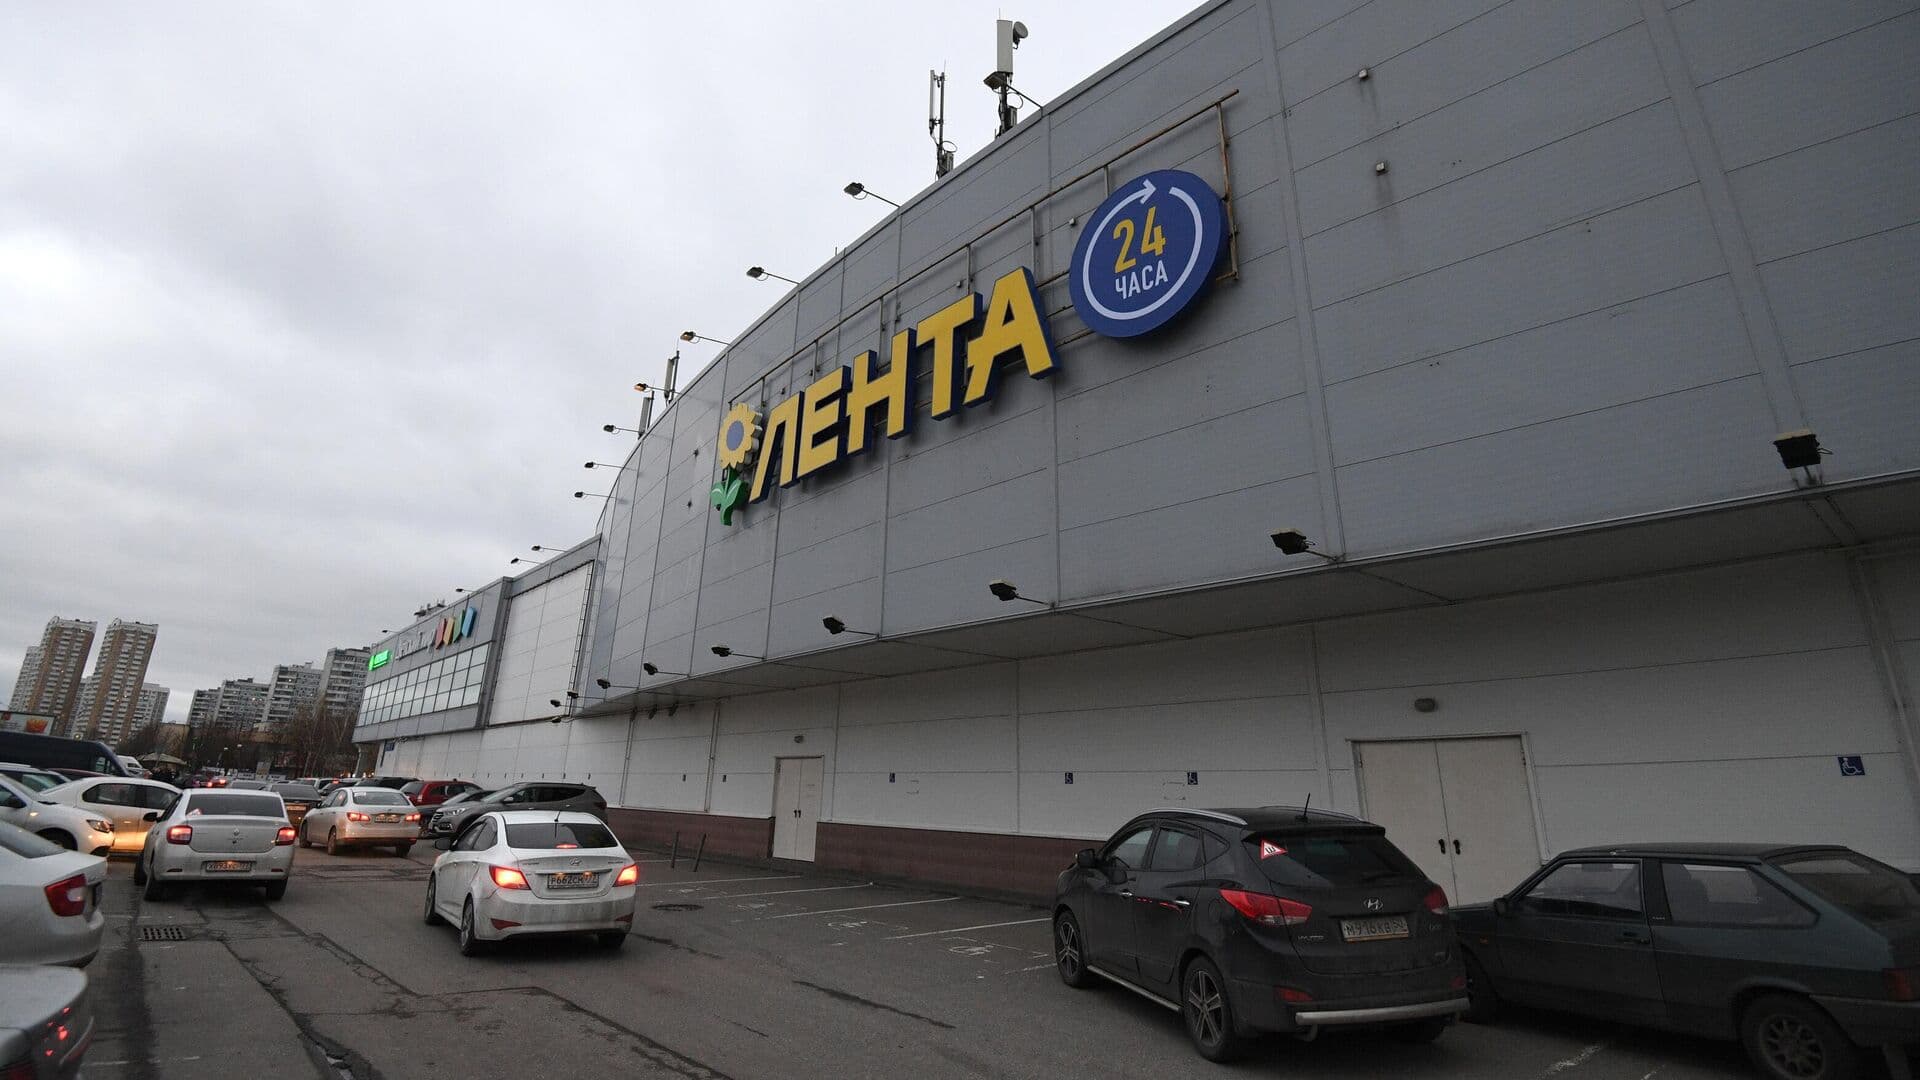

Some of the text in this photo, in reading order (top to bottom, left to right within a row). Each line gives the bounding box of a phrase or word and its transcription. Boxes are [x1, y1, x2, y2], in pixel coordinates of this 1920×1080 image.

[1113, 206, 1166, 273] 24
[1115, 259, 1168, 299] ЧАСА
[748, 265, 1057, 503] ЛЕНТА
